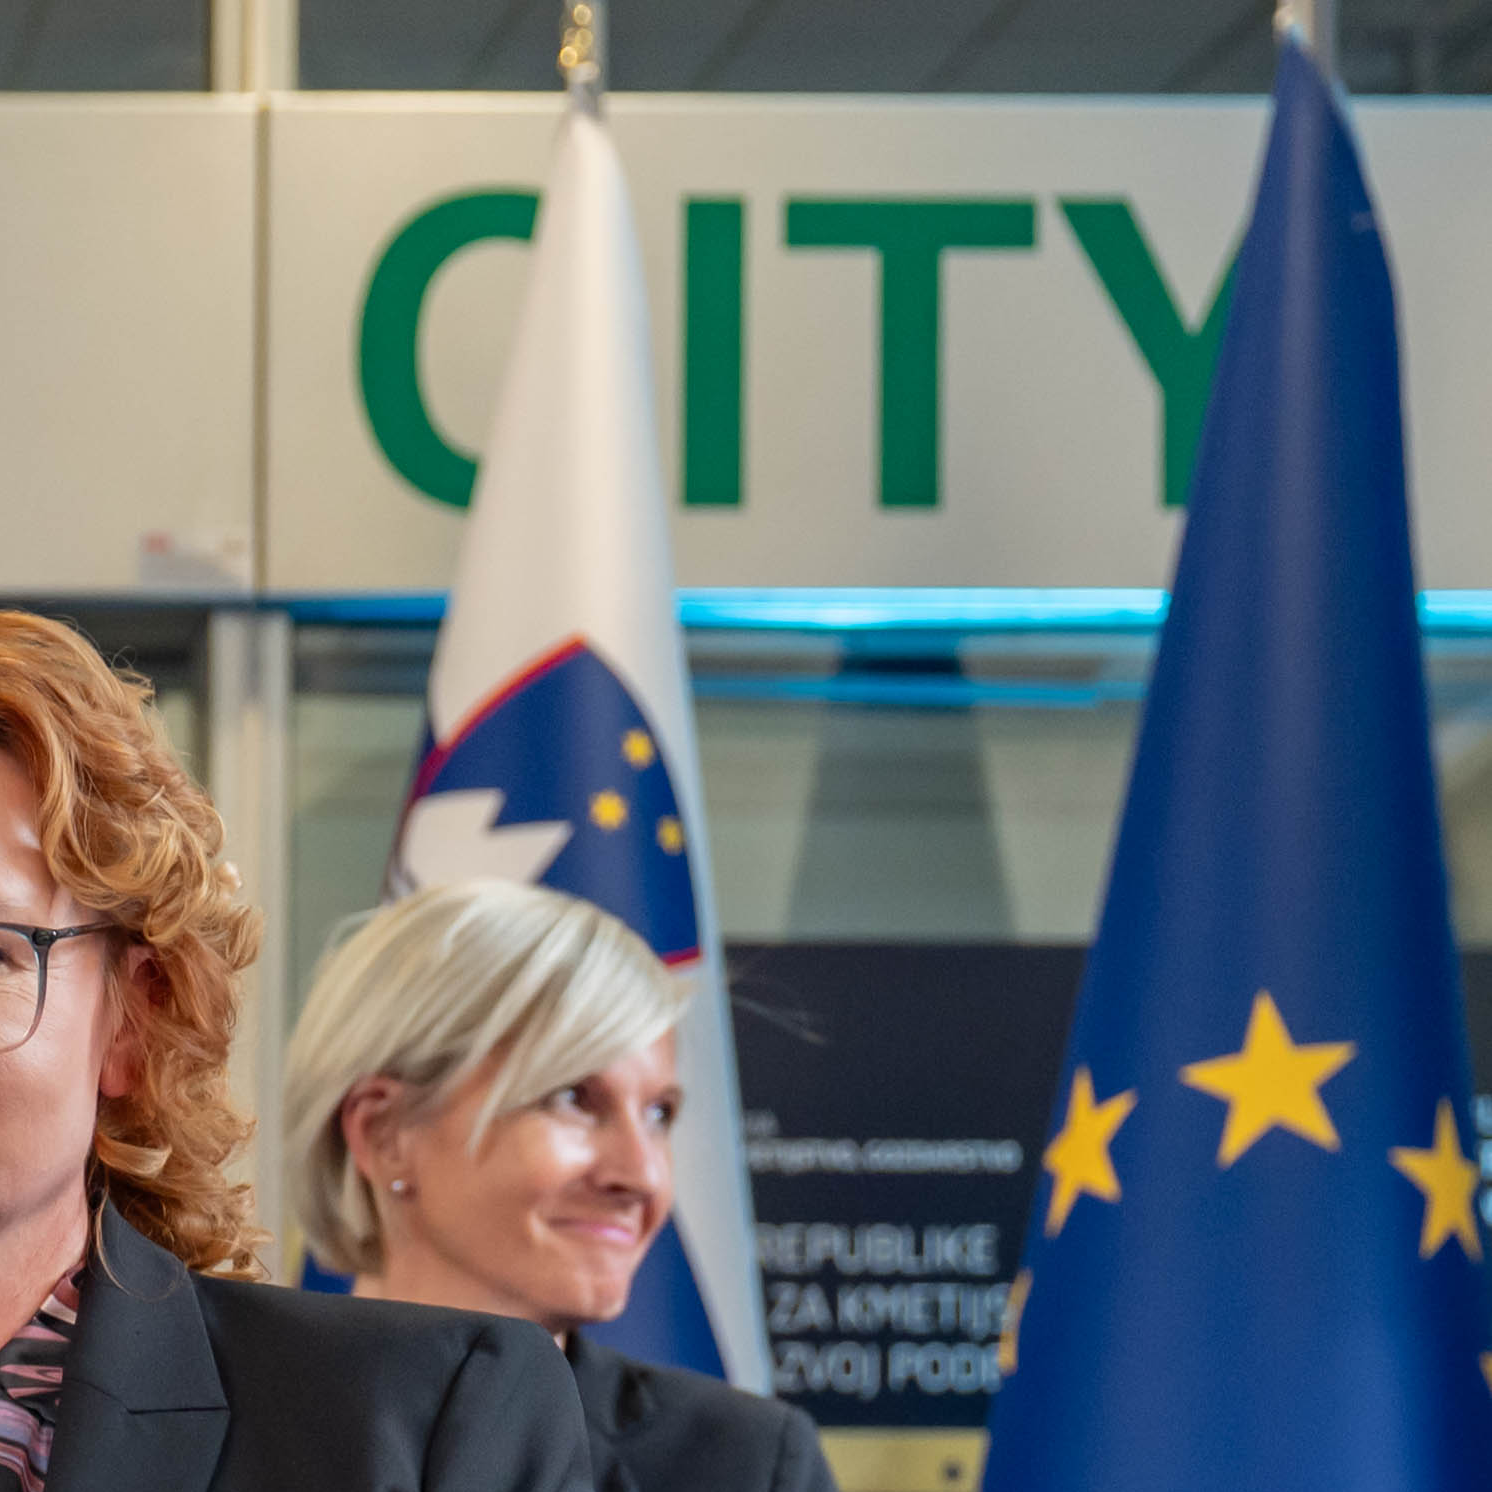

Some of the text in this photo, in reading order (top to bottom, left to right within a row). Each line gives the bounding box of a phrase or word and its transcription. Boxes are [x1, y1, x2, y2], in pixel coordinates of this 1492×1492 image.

[354, 187, 1243, 514] CITY
[754, 1225, 998, 1272] REPUBLIKE
[771, 1283, 1013, 1338] ZA KMETIJS
[775, 1343, 1003, 1398] ZVOJ PODE
